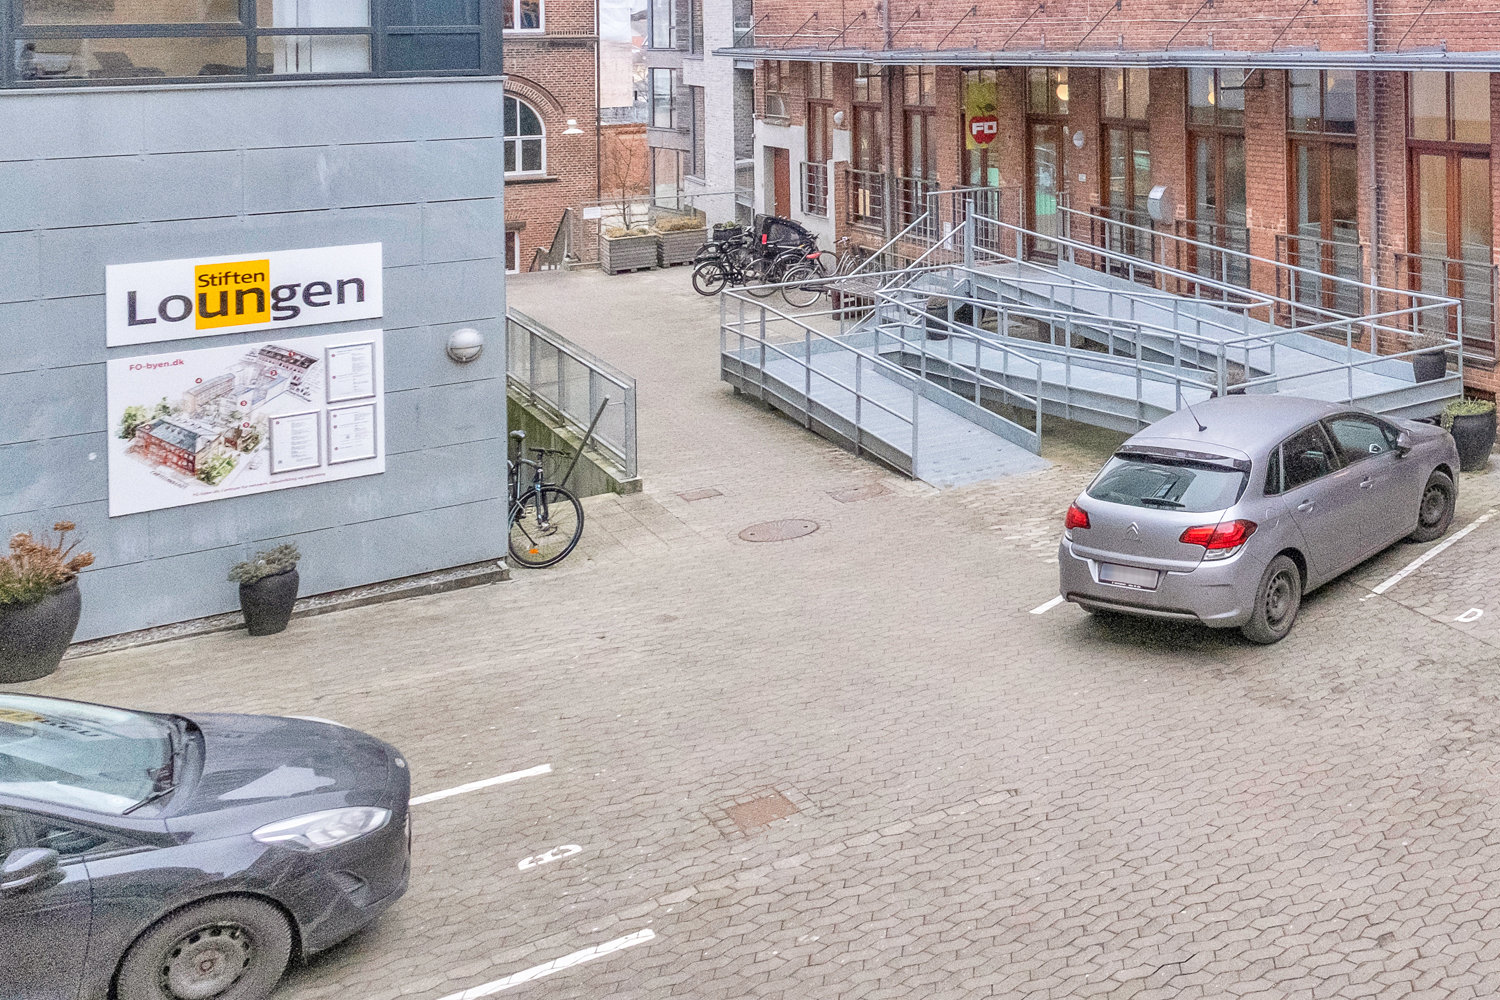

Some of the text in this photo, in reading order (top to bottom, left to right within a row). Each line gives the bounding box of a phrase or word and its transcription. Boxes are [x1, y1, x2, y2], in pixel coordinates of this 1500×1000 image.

[972, 121, 997, 135] FO
[198, 271, 265, 288] Stiften
[127, 277, 365, 326] Loungen
[129, 359, 184, 371] FO-byen.dk
